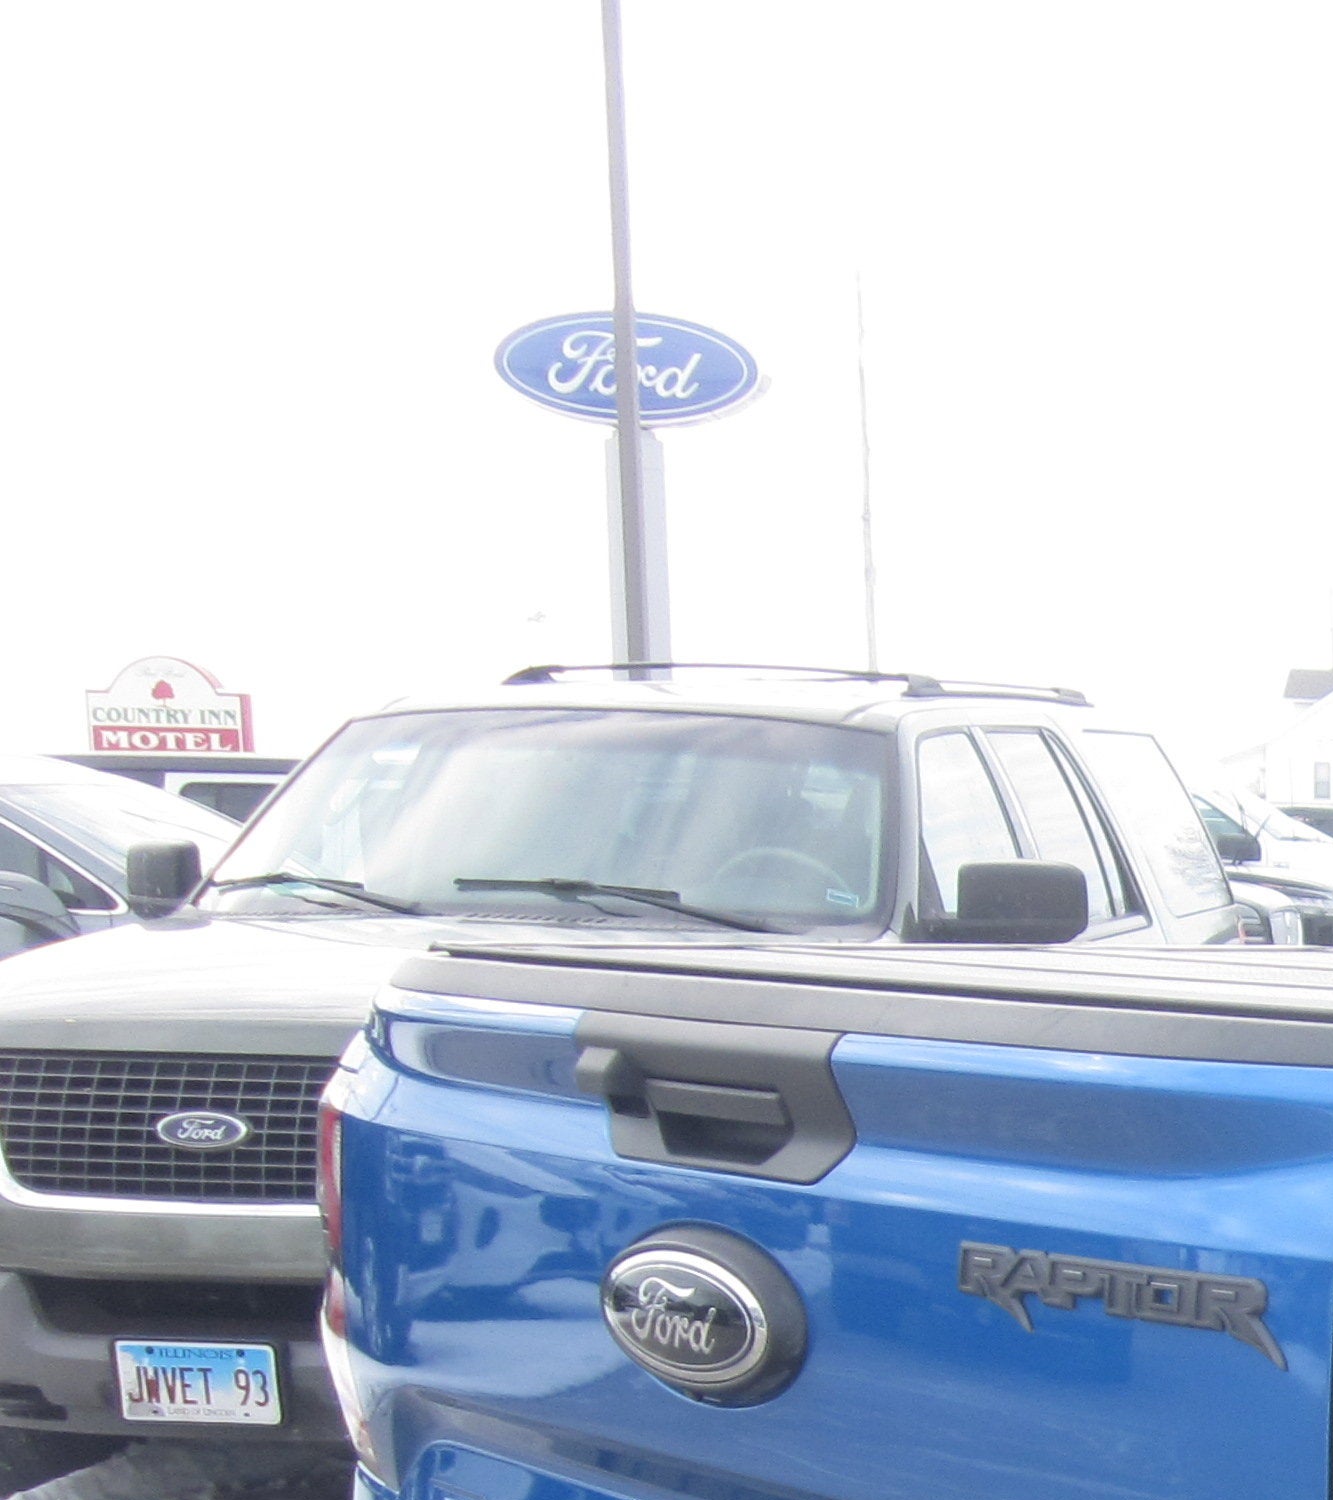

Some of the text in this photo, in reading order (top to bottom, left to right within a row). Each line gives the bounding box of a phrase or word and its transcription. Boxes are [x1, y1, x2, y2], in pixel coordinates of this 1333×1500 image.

[92, 706, 238, 726] COUNTRY INN
[100, 729, 232, 751] MOTEL
[176, 1118, 227, 1141] Ford
[631, 1276, 717, 1355] Ford
[958, 1240, 1289, 1372] RAPTOR
[128, 1365, 270, 1407] JWVET 93
